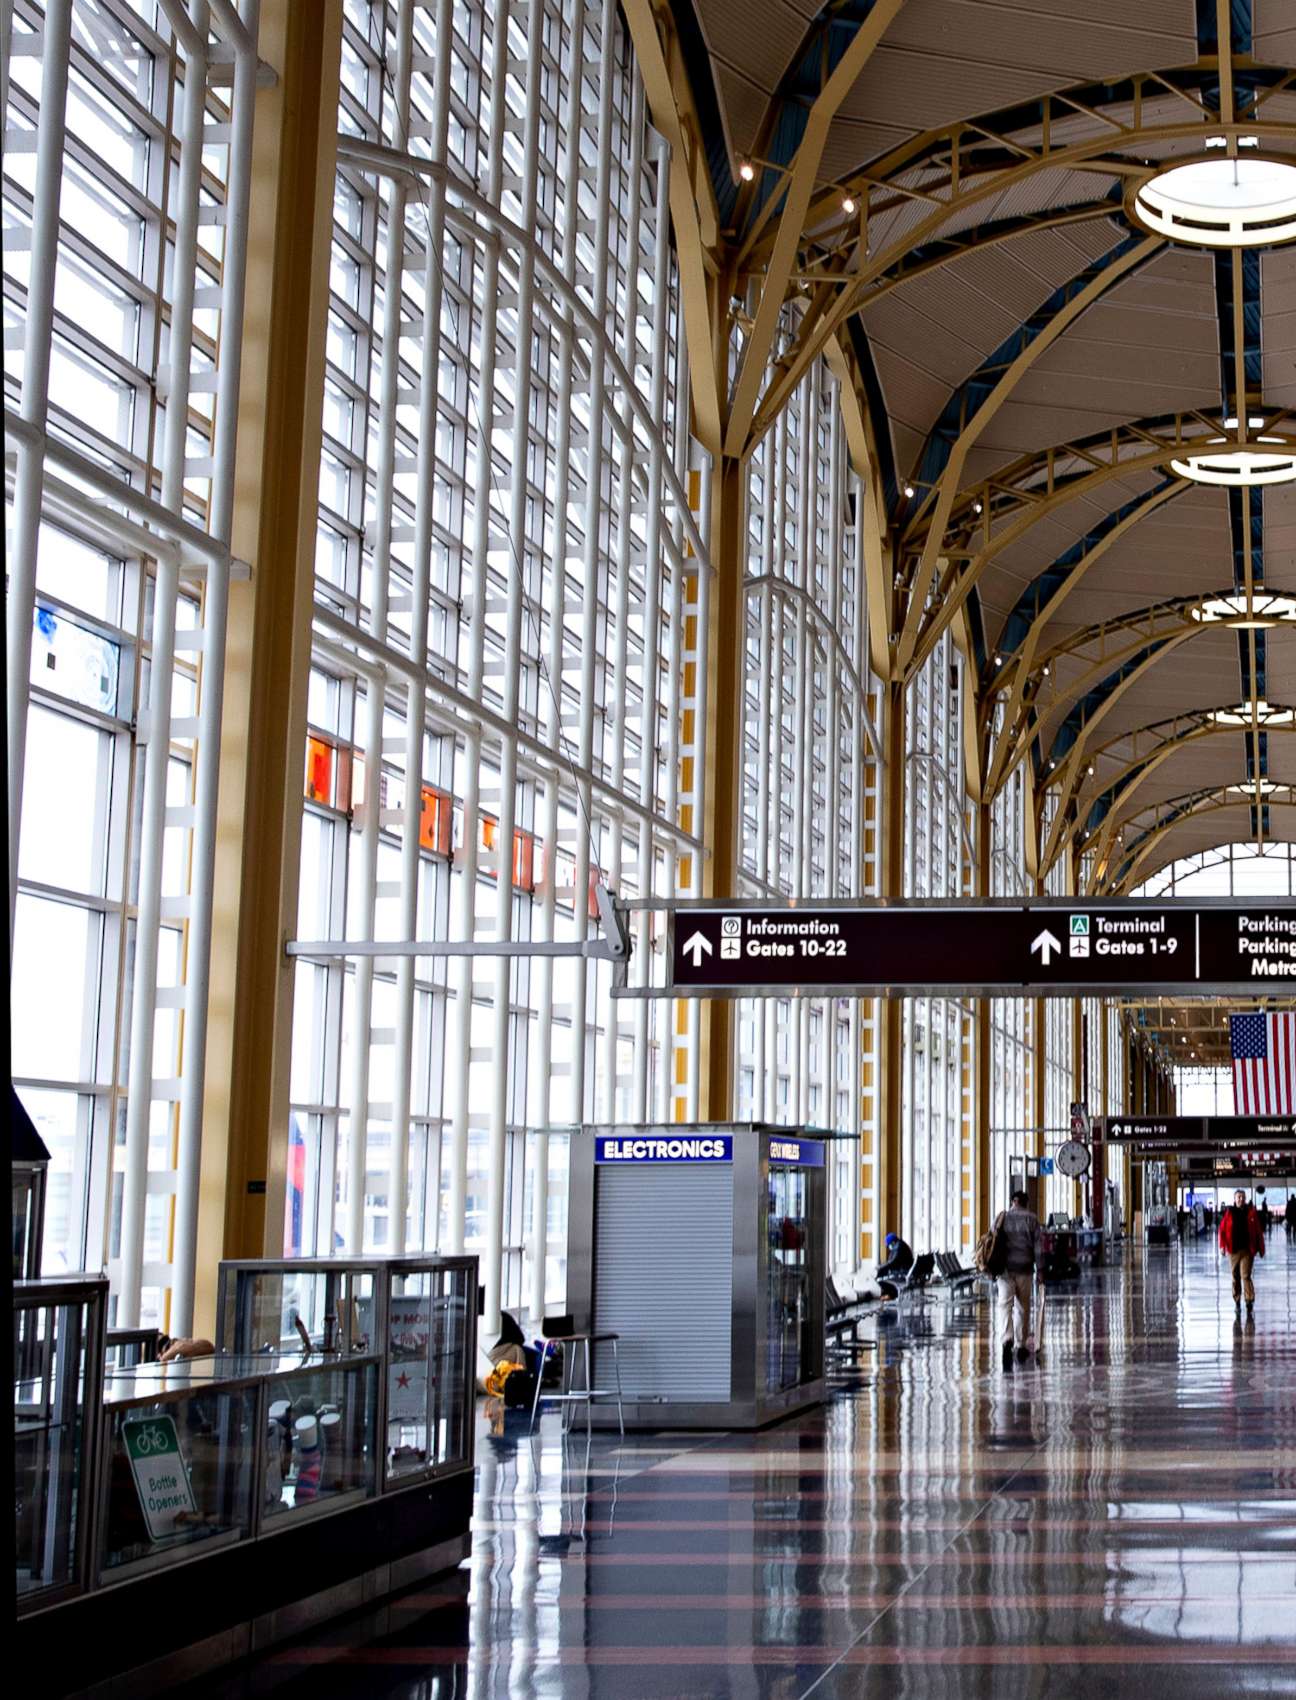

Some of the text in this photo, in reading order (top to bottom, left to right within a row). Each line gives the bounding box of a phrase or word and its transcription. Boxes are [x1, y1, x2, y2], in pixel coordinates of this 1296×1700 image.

[746, 917, 840, 936] Information
[1095, 915, 1165, 934] Terminal
[746, 939, 847, 957] Gates 10-22
[1095, 937, 1178, 957] Gates 1-9
[1134, 1125, 1153, 1134] Gates
[1257, 1124, 1283, 1133] Terminal
[603, 1139, 725, 1159] ELECTRONICS
[149, 1476, 177, 1493] Bottle
[148, 1494, 188, 1514] Openers
